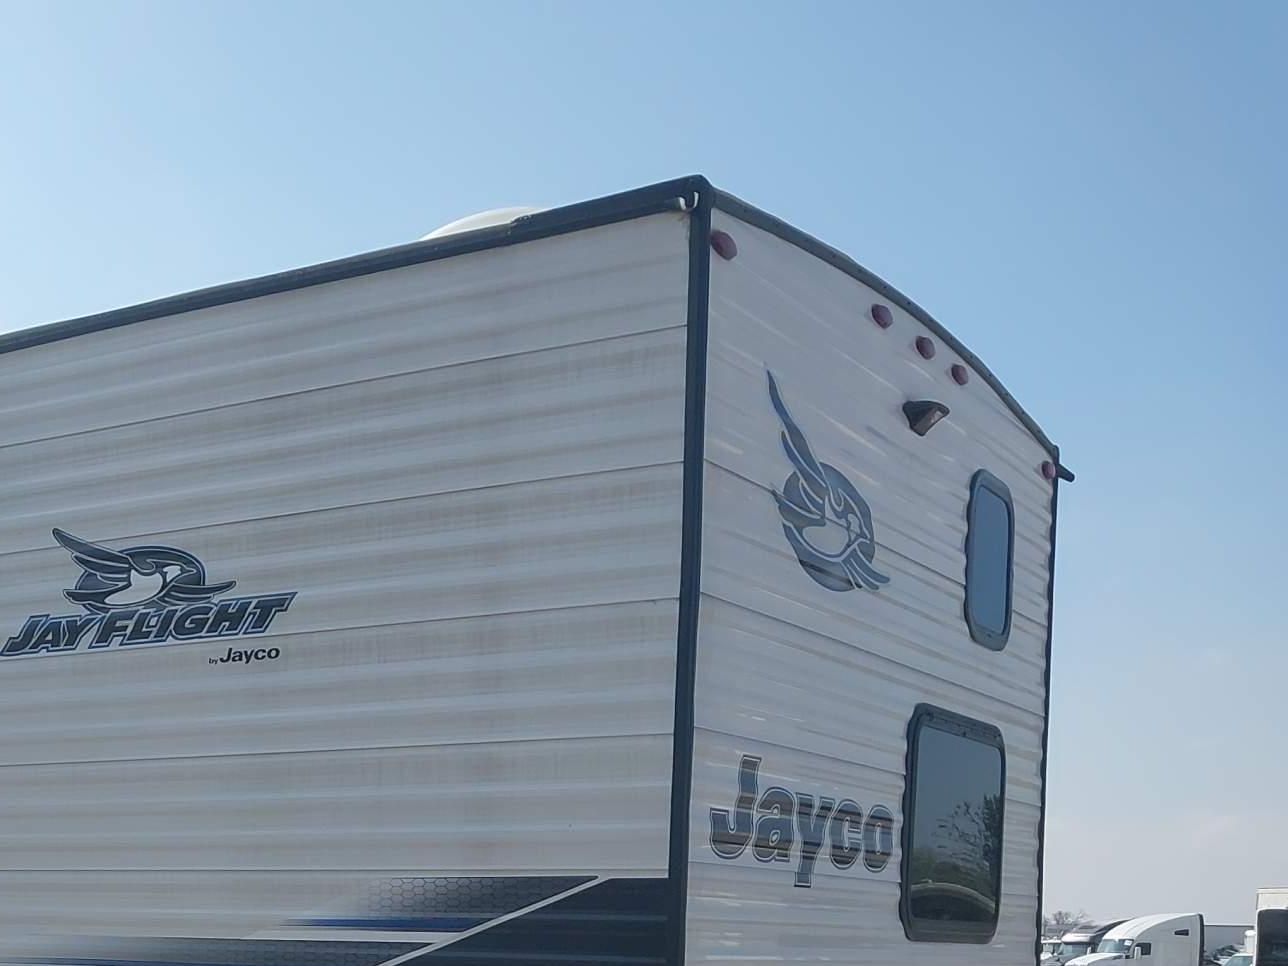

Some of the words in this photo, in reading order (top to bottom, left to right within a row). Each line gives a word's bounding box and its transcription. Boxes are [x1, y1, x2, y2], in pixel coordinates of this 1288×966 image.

[208, 656, 219, 665] by
[219, 647, 281, 665] Jayco
[709, 754, 894, 887] Jayco
